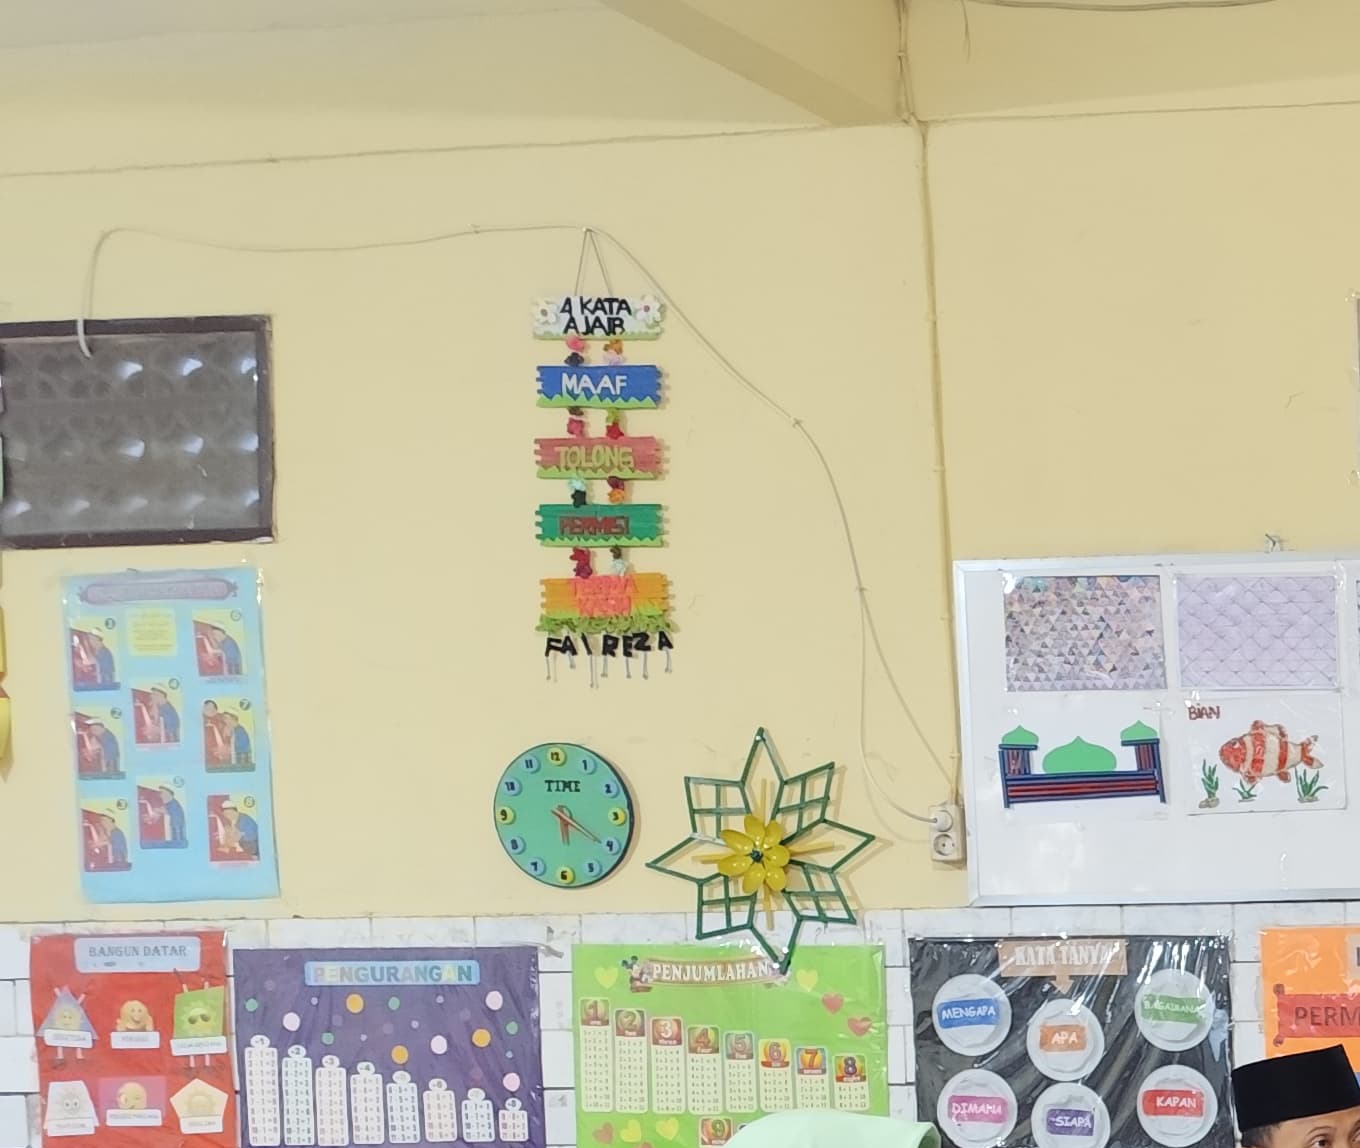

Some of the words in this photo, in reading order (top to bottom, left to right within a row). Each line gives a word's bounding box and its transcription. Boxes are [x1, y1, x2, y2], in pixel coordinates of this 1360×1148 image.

[580, 296, 632, 315] KATA
[563, 316, 625, 336] AJAIB
[562, 373, 627, 395] MAAF
[554, 446, 634, 472] TOLONG
[524, 759, 534, 769] 11
[550, 752, 561, 761] 12
[582, 759, 588, 771] 1
[544, 779, 581, 792] TIME
[605, 783, 612, 794] 2
[500, 809, 508, 821] 9
[612, 811, 619, 821] 3
[606, 840, 614, 852] 4
[530, 861, 538, 872] 7
[588, 862, 594, 873] 5
[560, 870, 568, 881] 6
[89, 946, 139, 957] BANGUN
[143, 945, 187, 957] DATAR
[1015, 949, 1051, 965] KATA
[313, 965, 473, 983] PENGURANGAN
[652, 960, 770, 982] PENJUMLAHAN
[588, 1001, 599, 1020] 1
[942, 1006, 996, 1021] MENGAPA
[623, 1013, 637, 1031] 2
[661, 1020, 672, 1038] 3
[694, 1027, 710, 1046] 4
[732, 1034, 747, 1052] 5
[1051, 1032, 1078, 1045] APA
[770, 1043, 782, 1061] 6
[805, 1050, 818, 1068] 7
[843, 1056, 858, 1075] 8
[1156, 1096, 1197, 1109] KAPAN
[711, 1120, 726, 1136] 9
[1054, 1115, 1092, 1128] SIAPA
